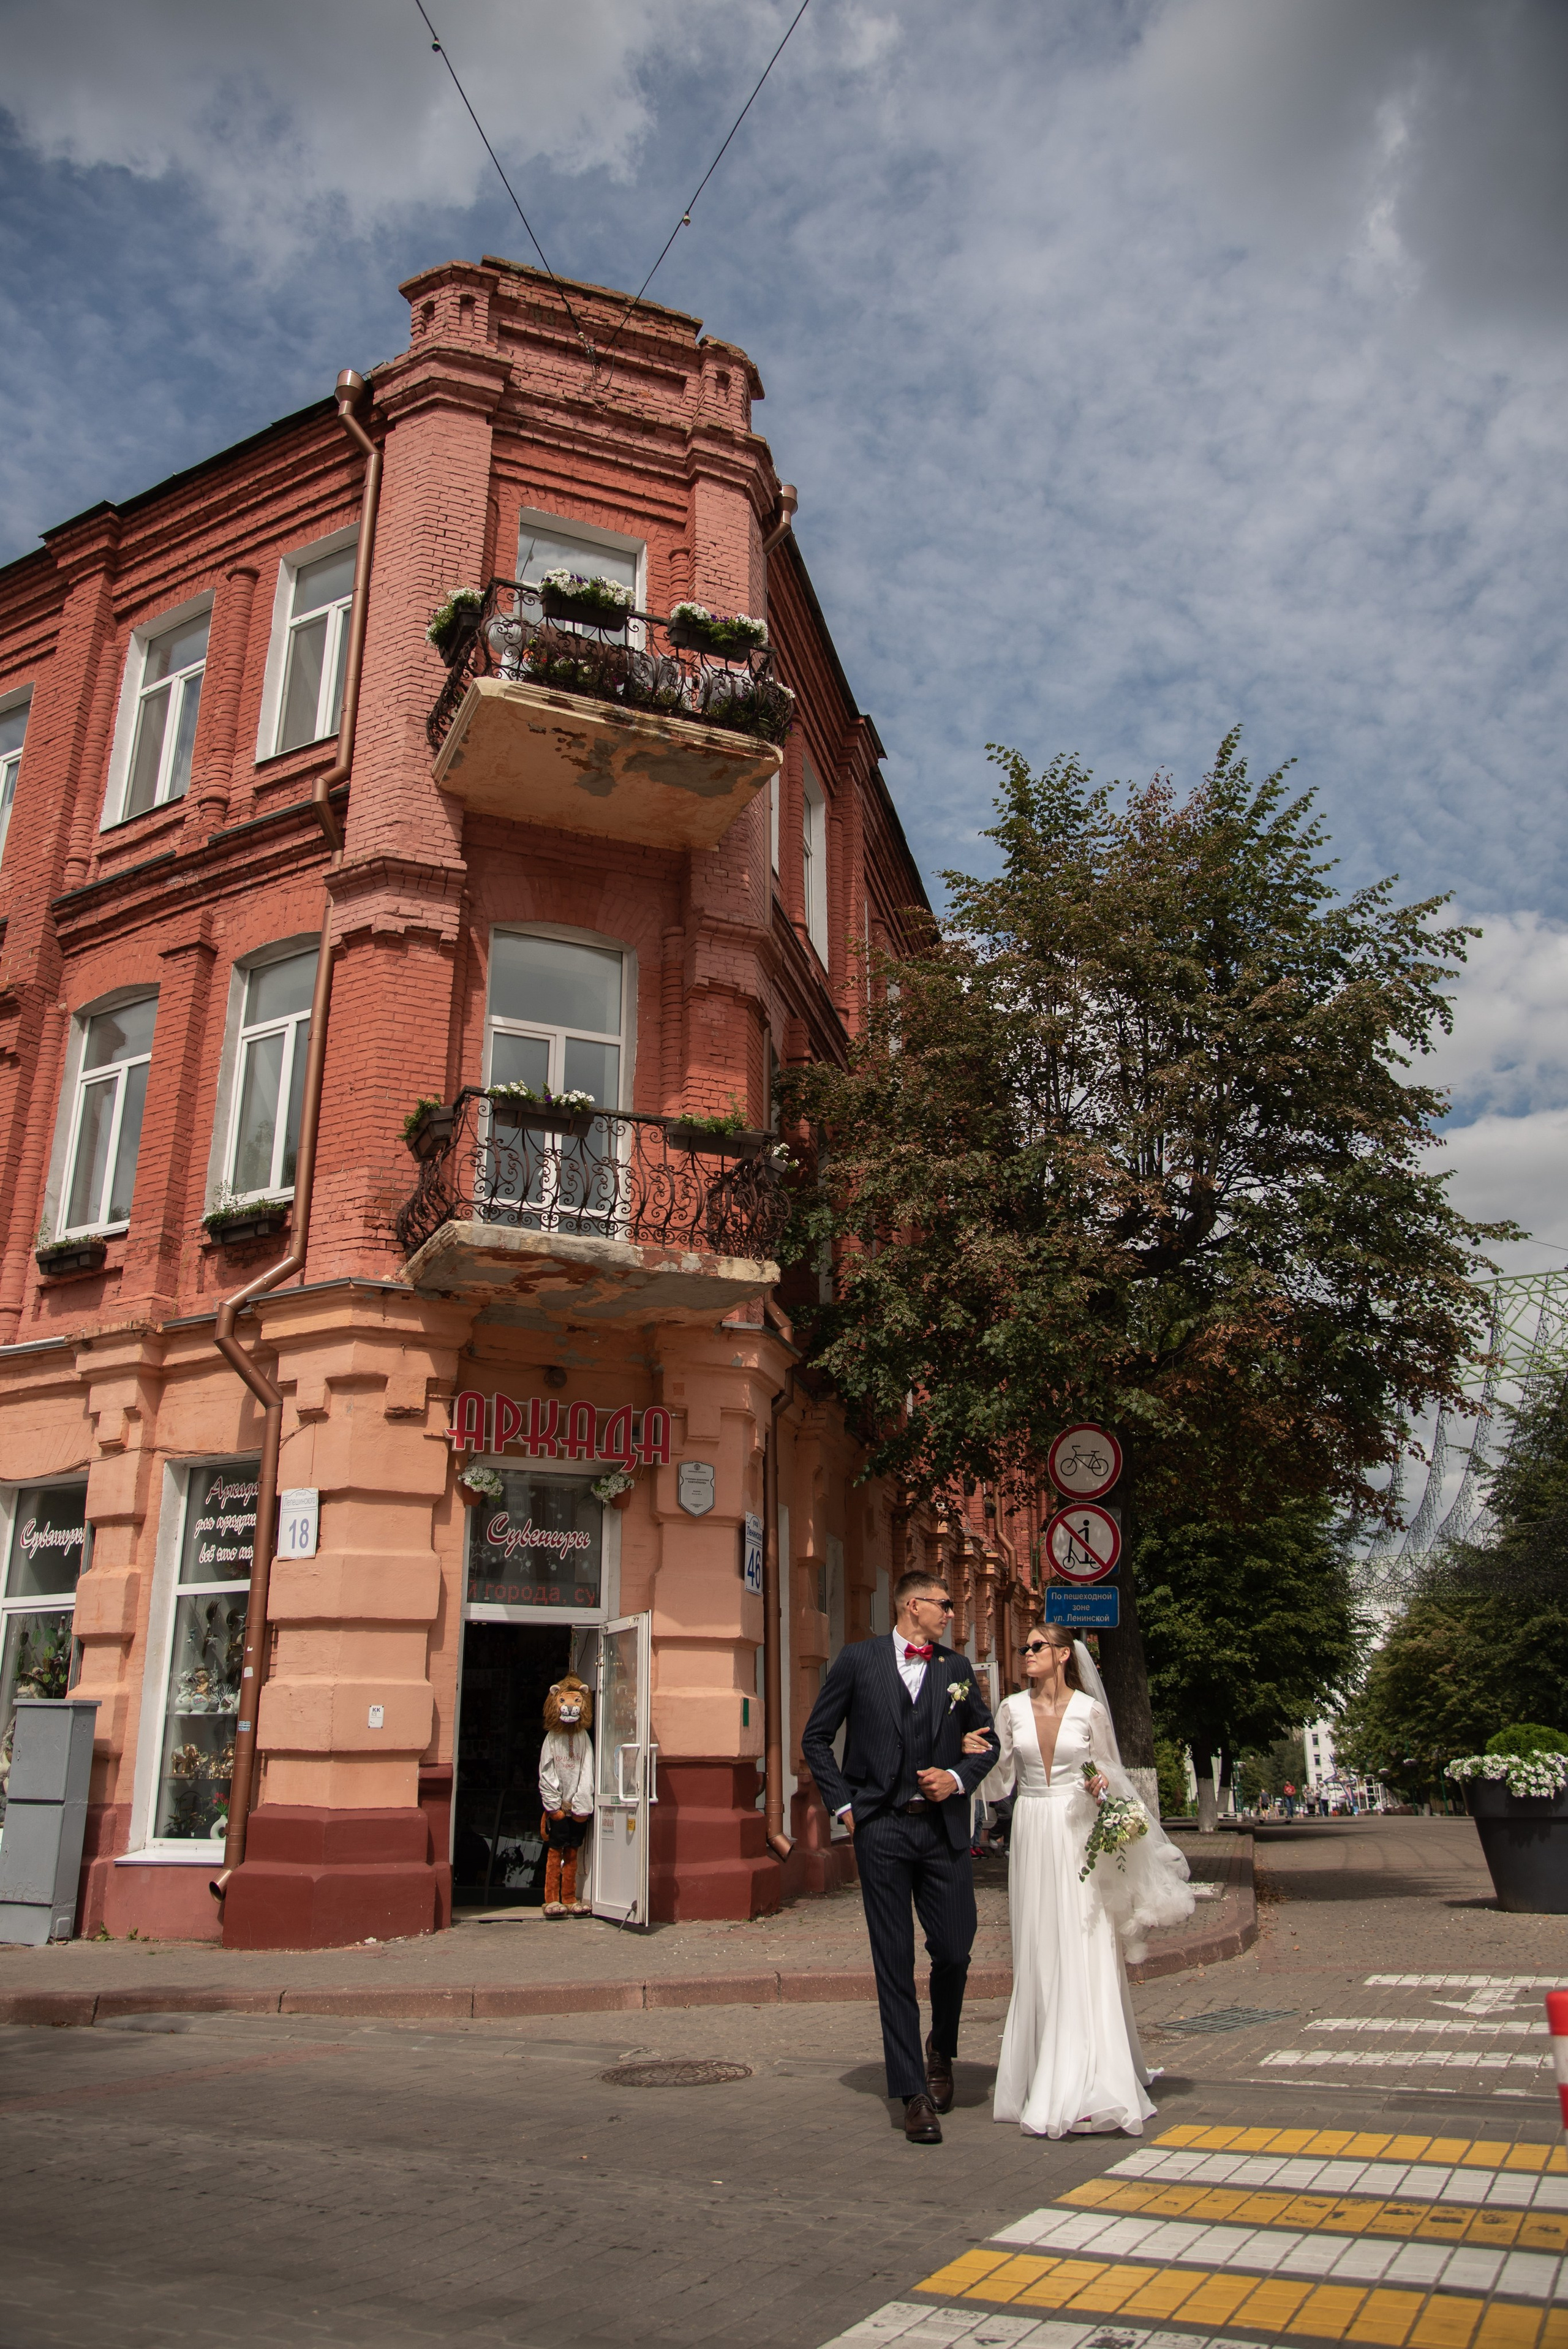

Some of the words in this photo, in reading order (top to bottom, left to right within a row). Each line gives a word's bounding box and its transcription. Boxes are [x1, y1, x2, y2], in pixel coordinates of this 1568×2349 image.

[443, 1390, 671, 1472] АРКАДА
[205, 1475, 259, 1509] Аркада
[284, 1497, 316, 1507] Лепешинского
[194, 1517, 215, 1539] для
[289, 1518, 309, 1549] 18
[486, 1511, 591, 1559] Сувениры
[747, 1548, 761, 1589] 46
[484, 1583, 567, 1605] города,
[1064, 1592, 1112, 1601] пешеходной
[1067, 1613, 1110, 1622] Ленинской
